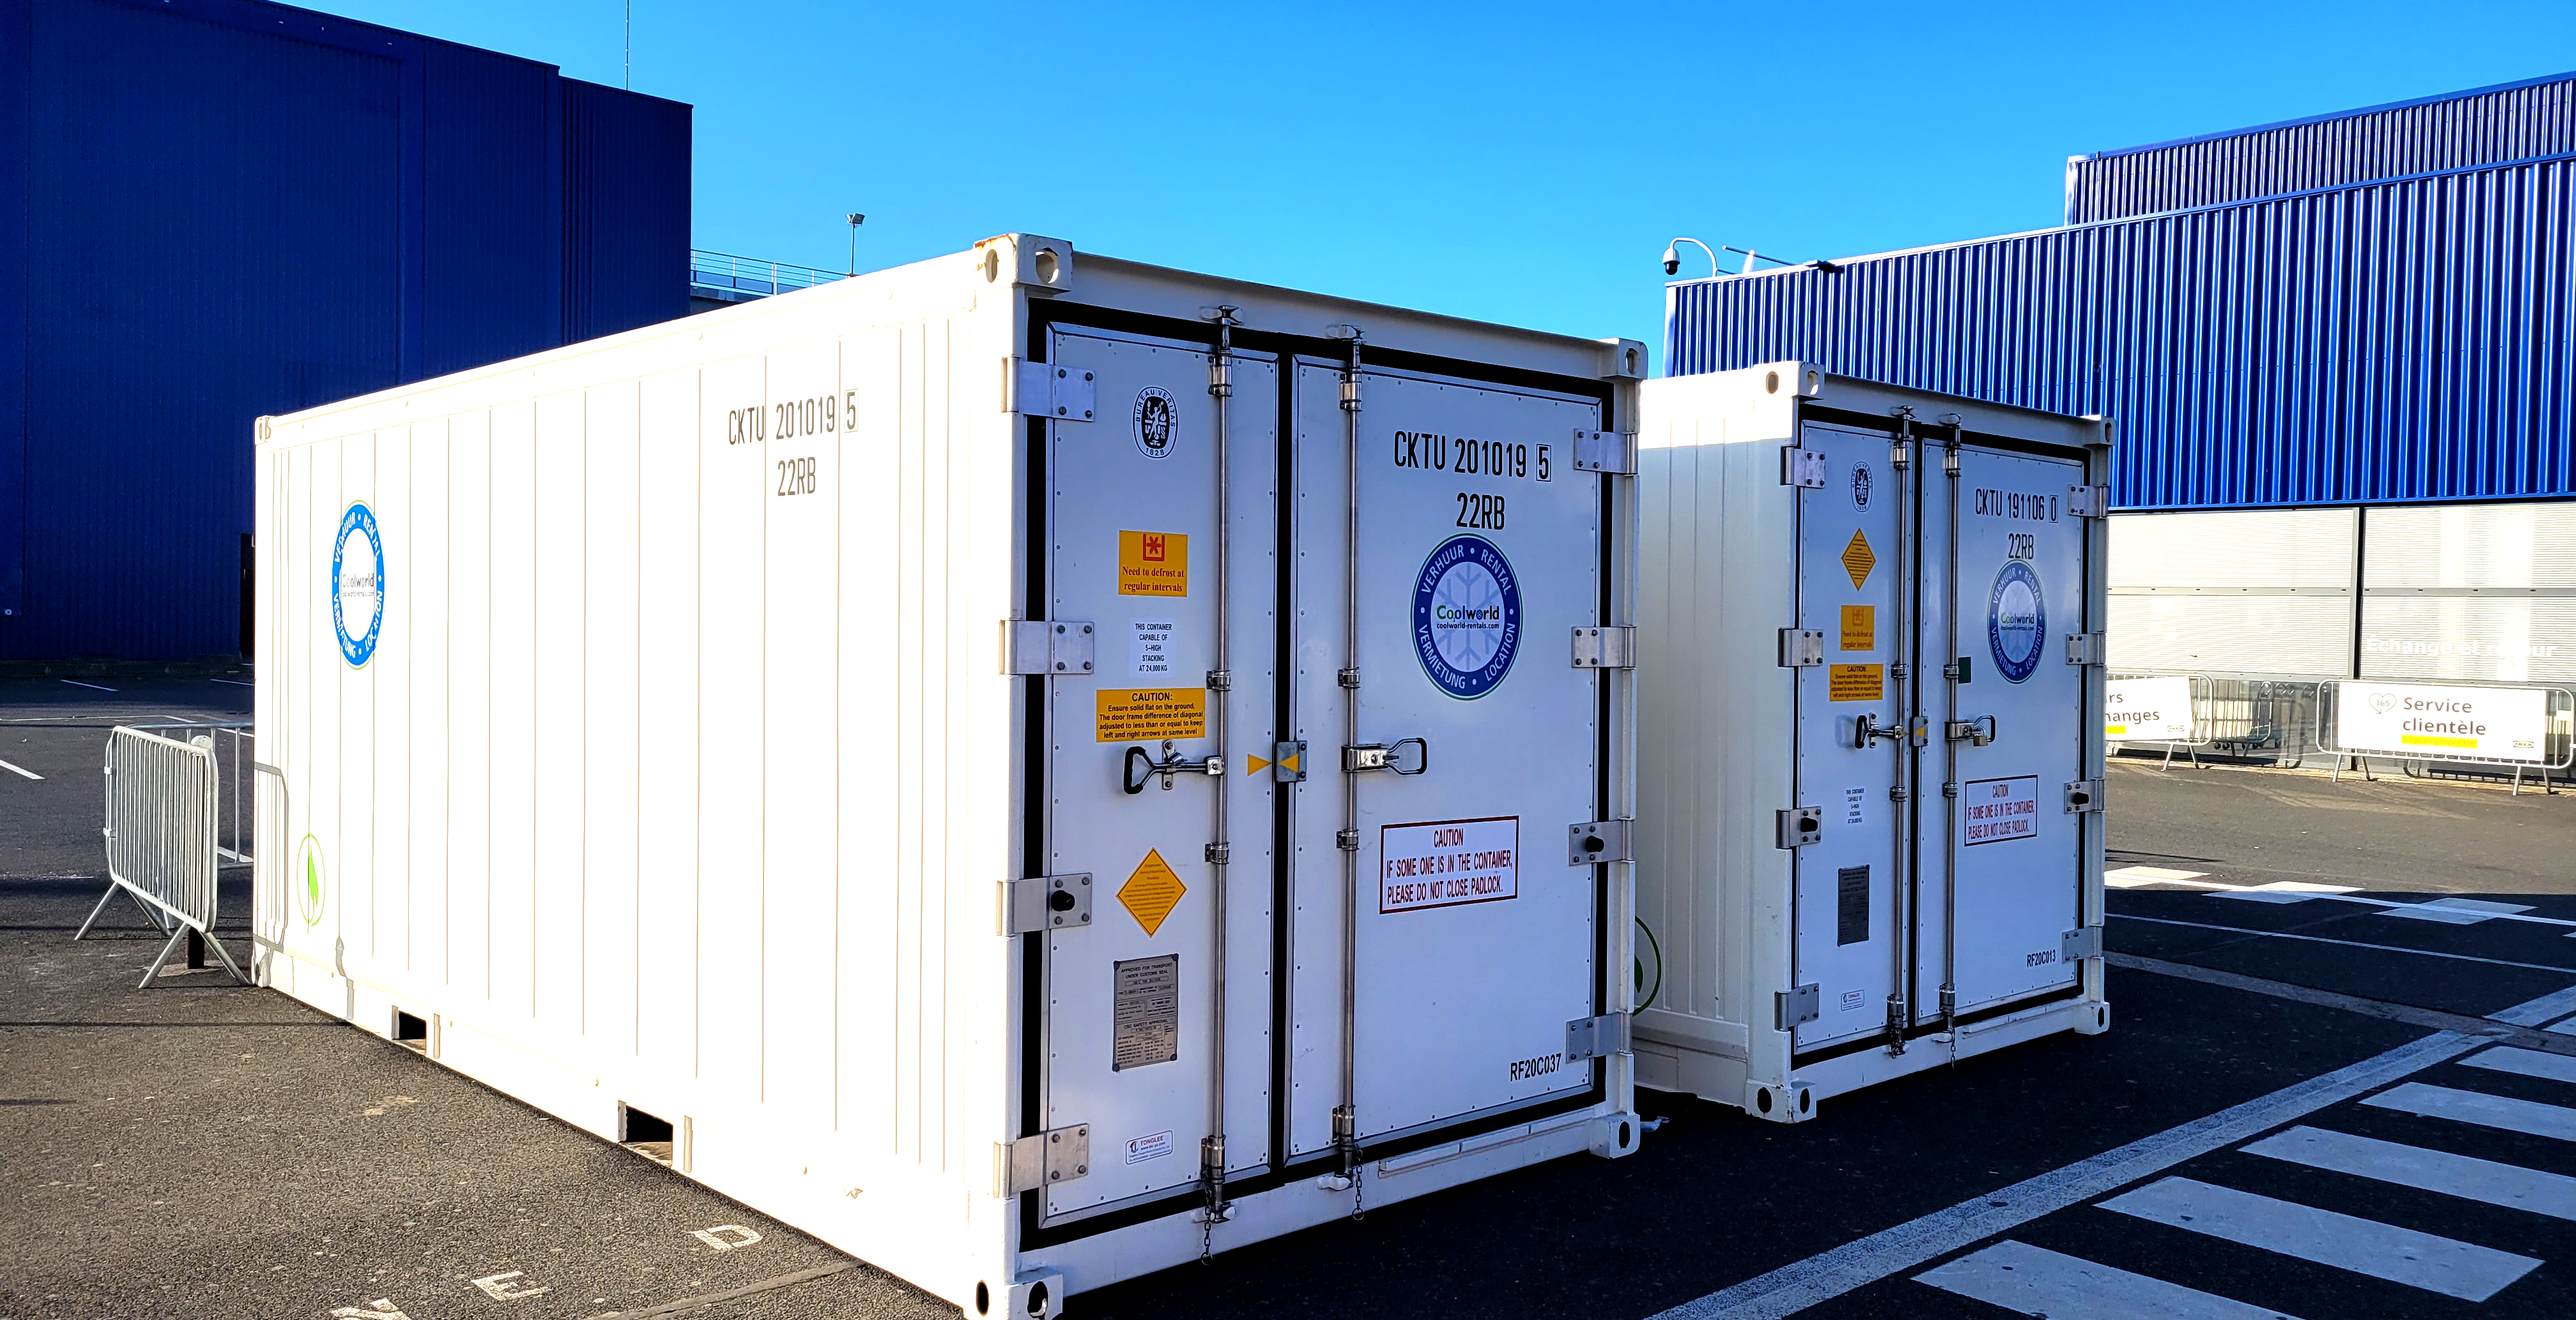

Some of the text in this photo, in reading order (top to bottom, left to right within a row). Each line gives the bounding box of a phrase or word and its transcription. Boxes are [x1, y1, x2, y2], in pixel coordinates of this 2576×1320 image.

[729, 390, 856, 445] CKTU 201019 5
[1136, 389, 1175, 427] BUREAU VERITAS
[1146, 448, 1164, 456] 1828
[1394, 431, 1550, 480] CKTU 201019 5
[778, 457, 815, 496] 22RB
[1457, 493, 1504, 530] 22RB
[1976, 489, 2002, 516] CKTU
[2008, 493, 2044, 520] 191106
[2008, 533, 2034, 559] 22RB
[1123, 566, 1140, 575] Need
[1151, 568, 1175, 577] defrost
[1422, 545, 1512, 595] VERHUUR RENTAL
[1124, 582, 1182, 592] regular intervals
[1993, 568, 2040, 606] VERHUUR RENTAL
[2001, 613, 2034, 624] Coolworld
[1419, 623, 1515, 689] VERMIETUNG LOCATION
[1992, 627, 2043, 676] VERMIETUNG LOCATION
[1132, 692, 1172, 701] CAUTION:
[2403, 697, 2472, 713] Service
[1099, 723, 1124, 731] adjusted
[1127, 731, 1140, 739] right
[2402, 718, 2486, 735] clientèle
[1993, 784, 2008, 798] CAUTION
[1434, 828, 1464, 848] CAUTION
[1969, 825, 1982, 839] PLEASE
[2000, 821, 2010, 835] CLOSE
[1387, 850, 1512, 878] IF SOME ONE IS IN THE CONTAINER,
[1388, 875, 1503, 905] PLEASE DO NOT CLOSE PADLOCK.
[1510, 1053, 1561, 1081] RF20C037
